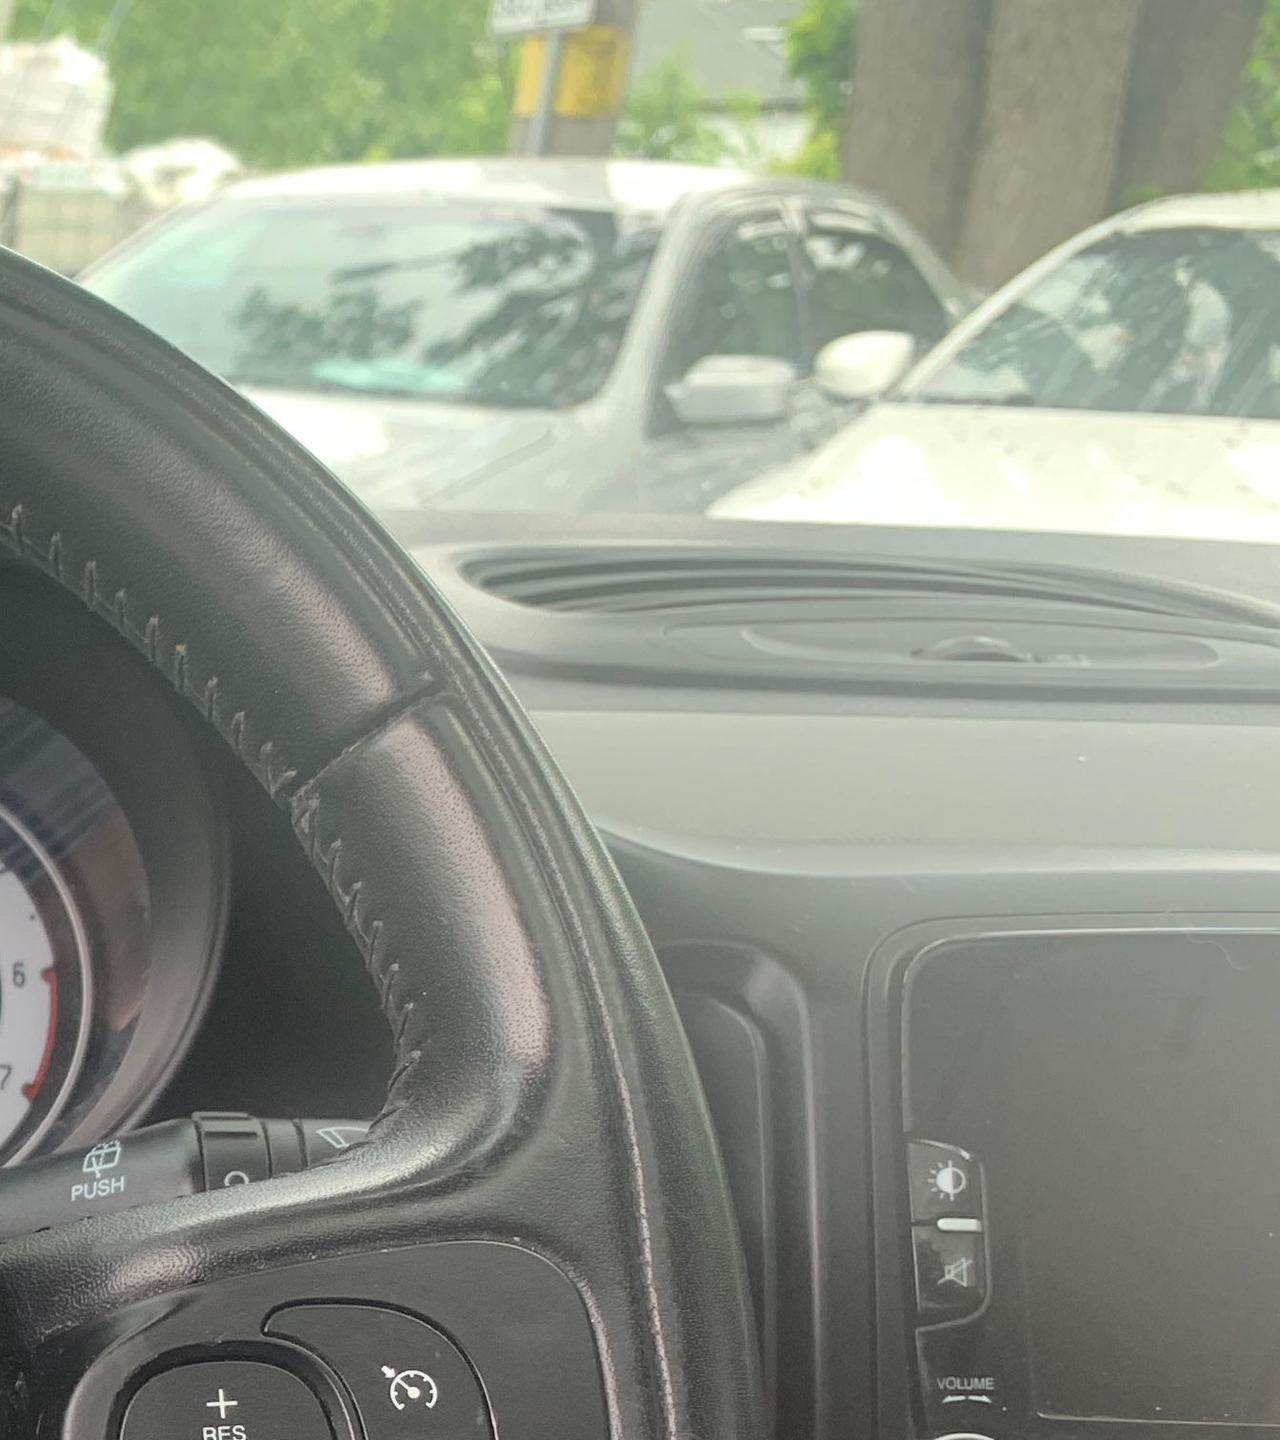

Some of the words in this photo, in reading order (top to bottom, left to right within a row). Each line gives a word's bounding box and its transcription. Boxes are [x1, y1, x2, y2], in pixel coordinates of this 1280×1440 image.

[12, 961, 26, 987] 6
[71, 1175, 126, 1202] PUSH
[936, 1377, 995, 1391] VOLUME
